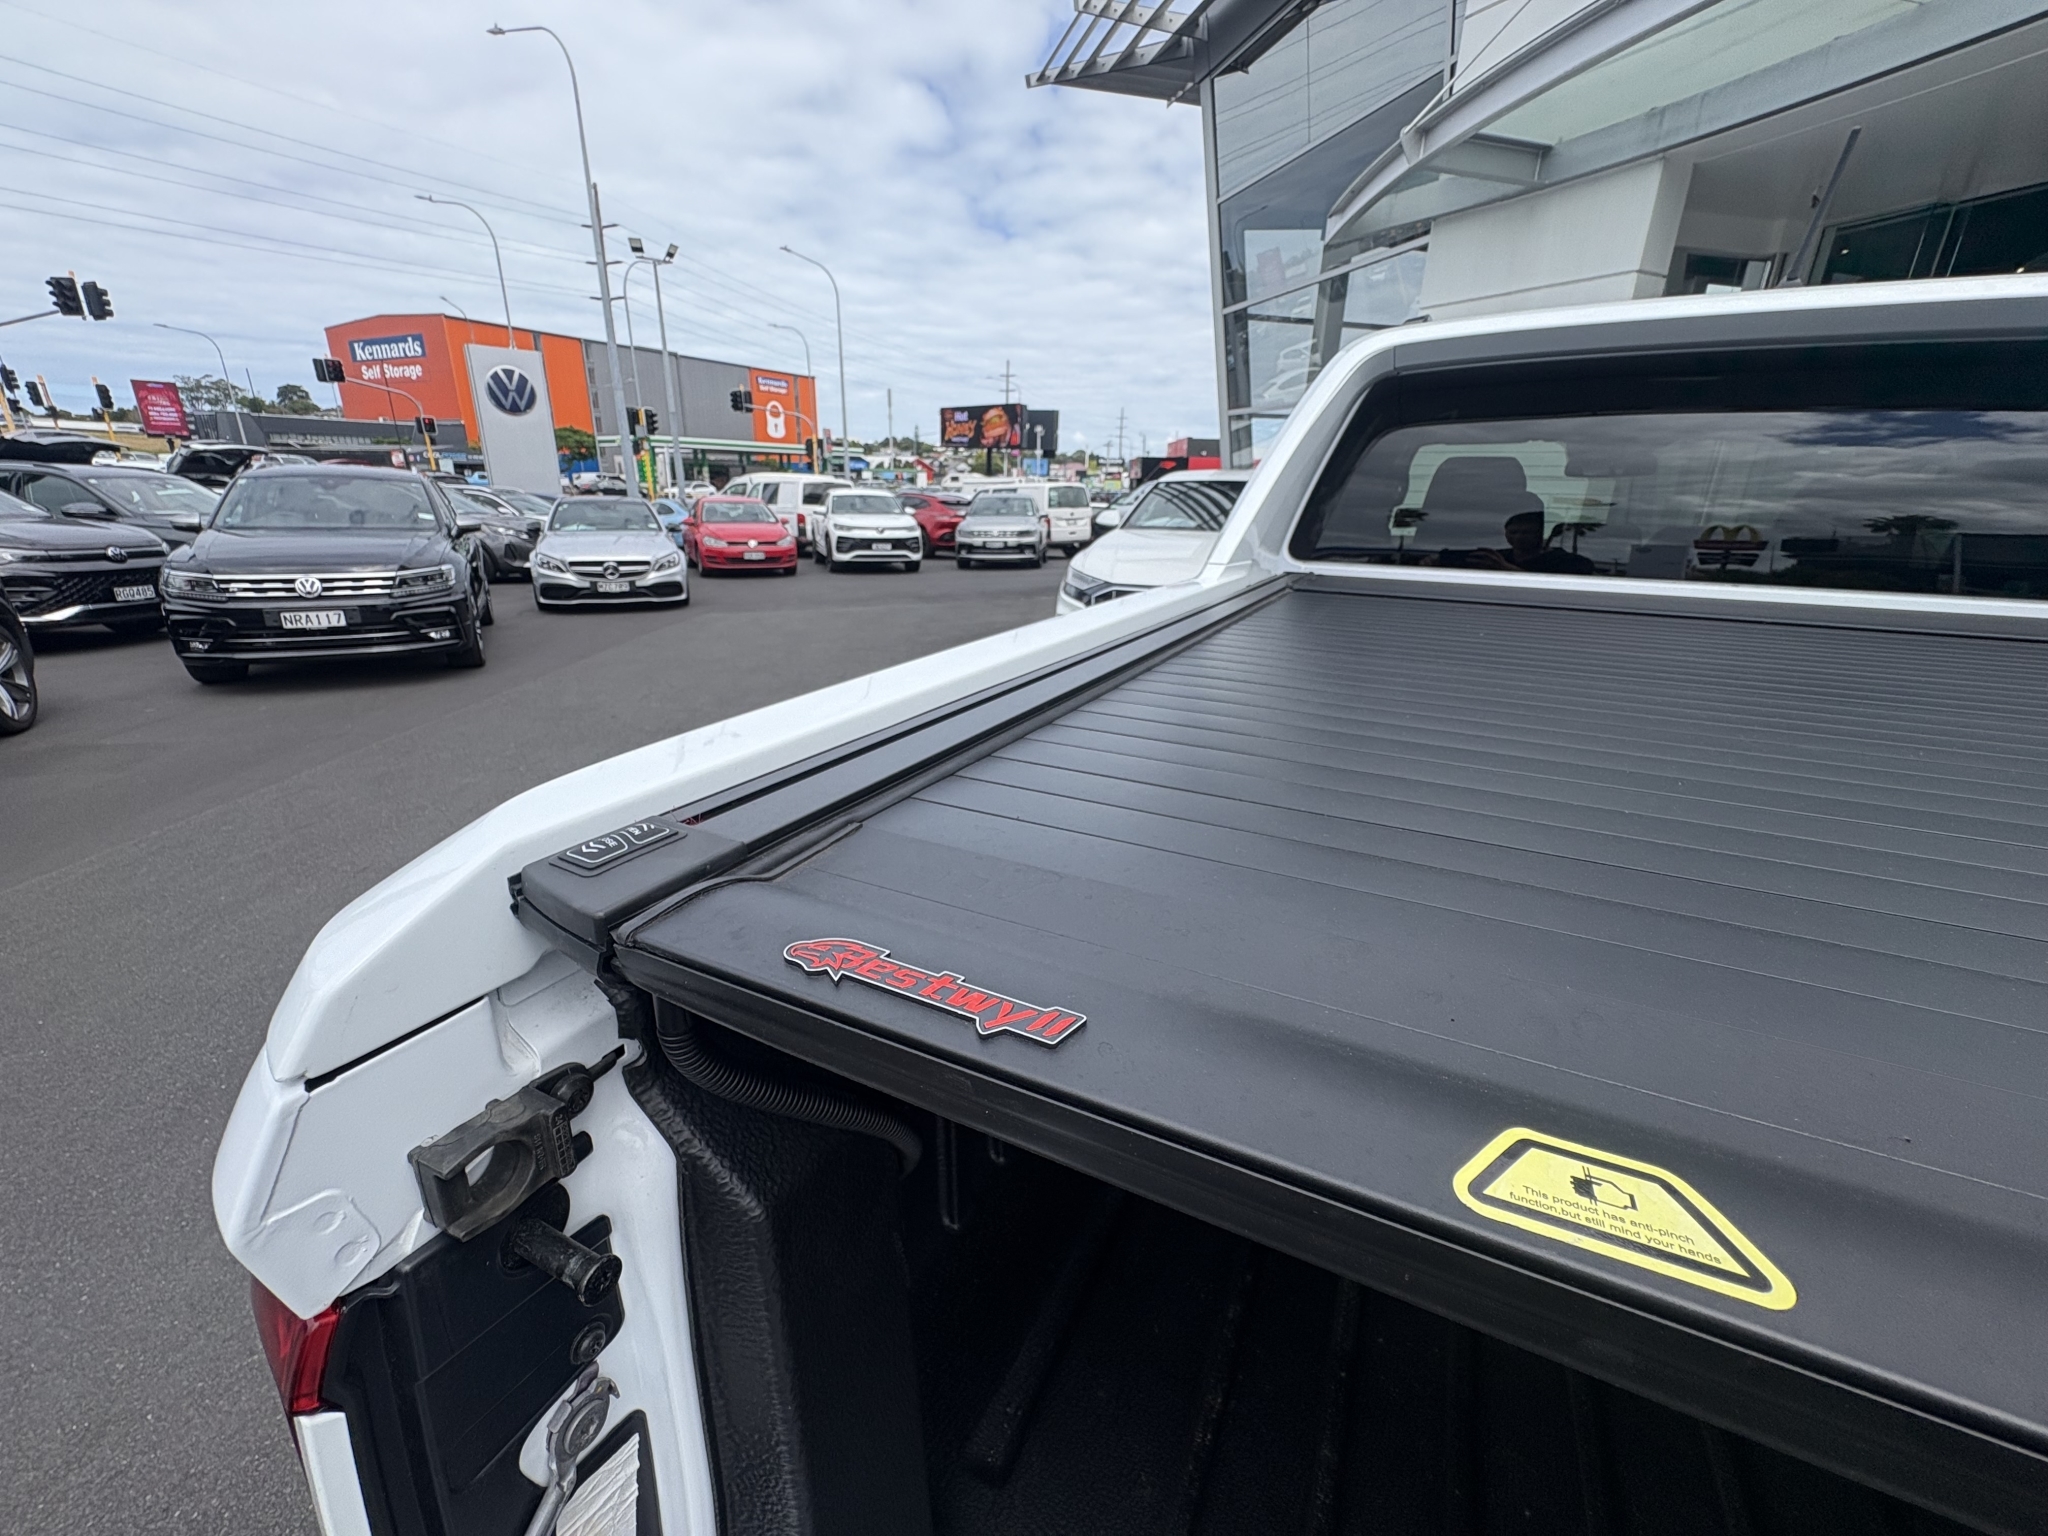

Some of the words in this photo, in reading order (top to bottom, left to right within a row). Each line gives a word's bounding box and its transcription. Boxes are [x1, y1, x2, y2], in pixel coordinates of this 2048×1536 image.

[353, 336, 423, 361] Kennards
[361, 364, 381, 380] Self
[383, 363, 422, 380] Storage
[282, 612, 342, 627] NRA117
[1522, 1185, 1549, 1201] This
[1552, 1195, 1600, 1216] product
[1602, 1208, 1626, 1223] has
[1630, 1219, 1695, 1246] anti-pinch
[1584, 1214, 1606, 1229] still
[1610, 1222, 1641, 1239] mind
[1644, 1234, 1675, 1250] your
[1678, 1243, 1722, 1265] hands
